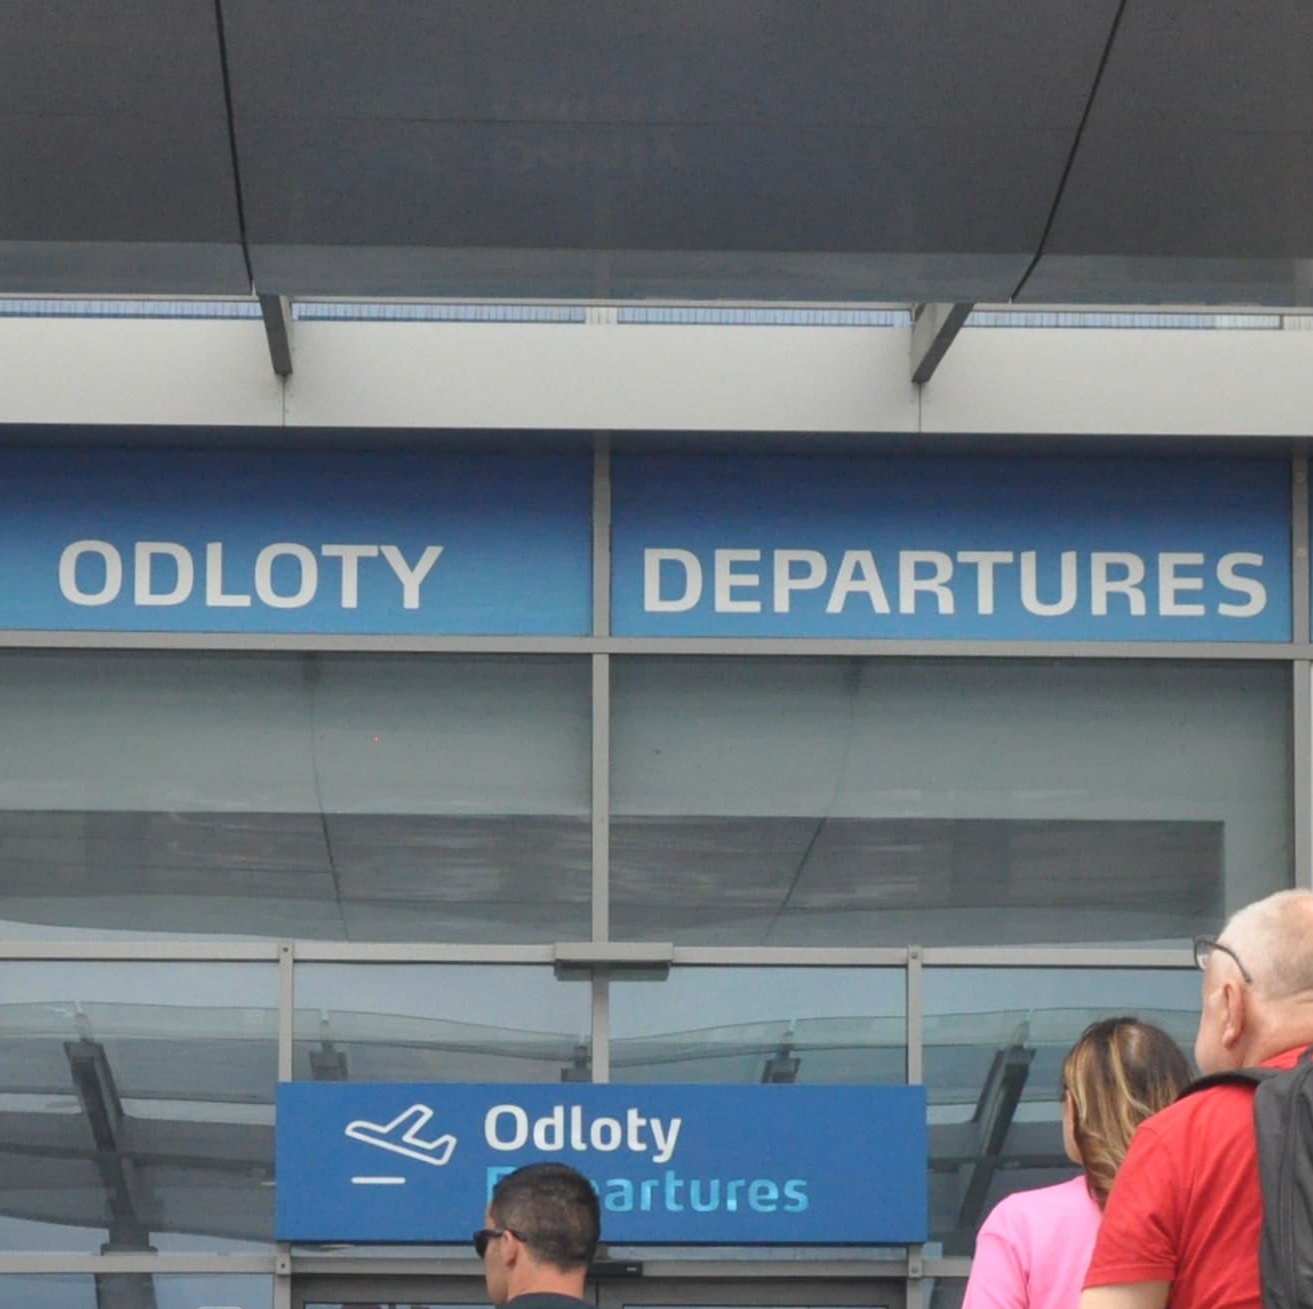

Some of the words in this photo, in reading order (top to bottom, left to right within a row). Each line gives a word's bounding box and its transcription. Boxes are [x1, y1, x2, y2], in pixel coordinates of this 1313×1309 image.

[58, 540, 444, 611] ODLOTY
[643, 547, 1268, 618] DEPARTURES
[484, 1104, 683, 1163] Odloty
[487, 1167, 809, 1213] artures
